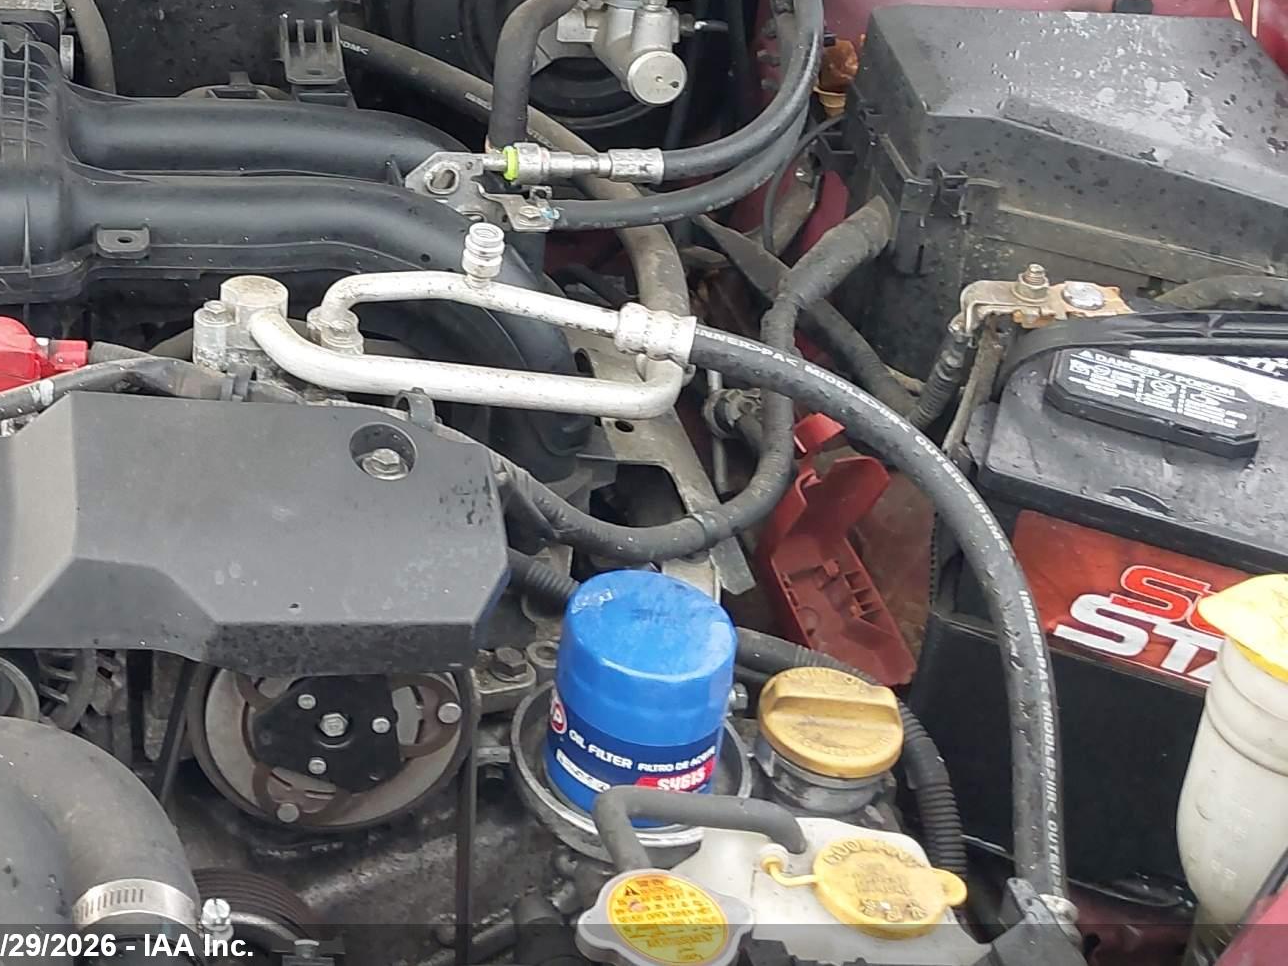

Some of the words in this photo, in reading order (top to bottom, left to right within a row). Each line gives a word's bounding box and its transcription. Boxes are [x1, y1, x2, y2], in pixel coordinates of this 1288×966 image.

[1095, 353, 1160, 377] DANGER
[1175, 374, 1236, 397] POISON
[568, 729, 587, 749] OIL
[588, 743, 634, 770] FILTER
[637, 762, 675, 773] FILTRO
[675, 760, 690, 771] DE
